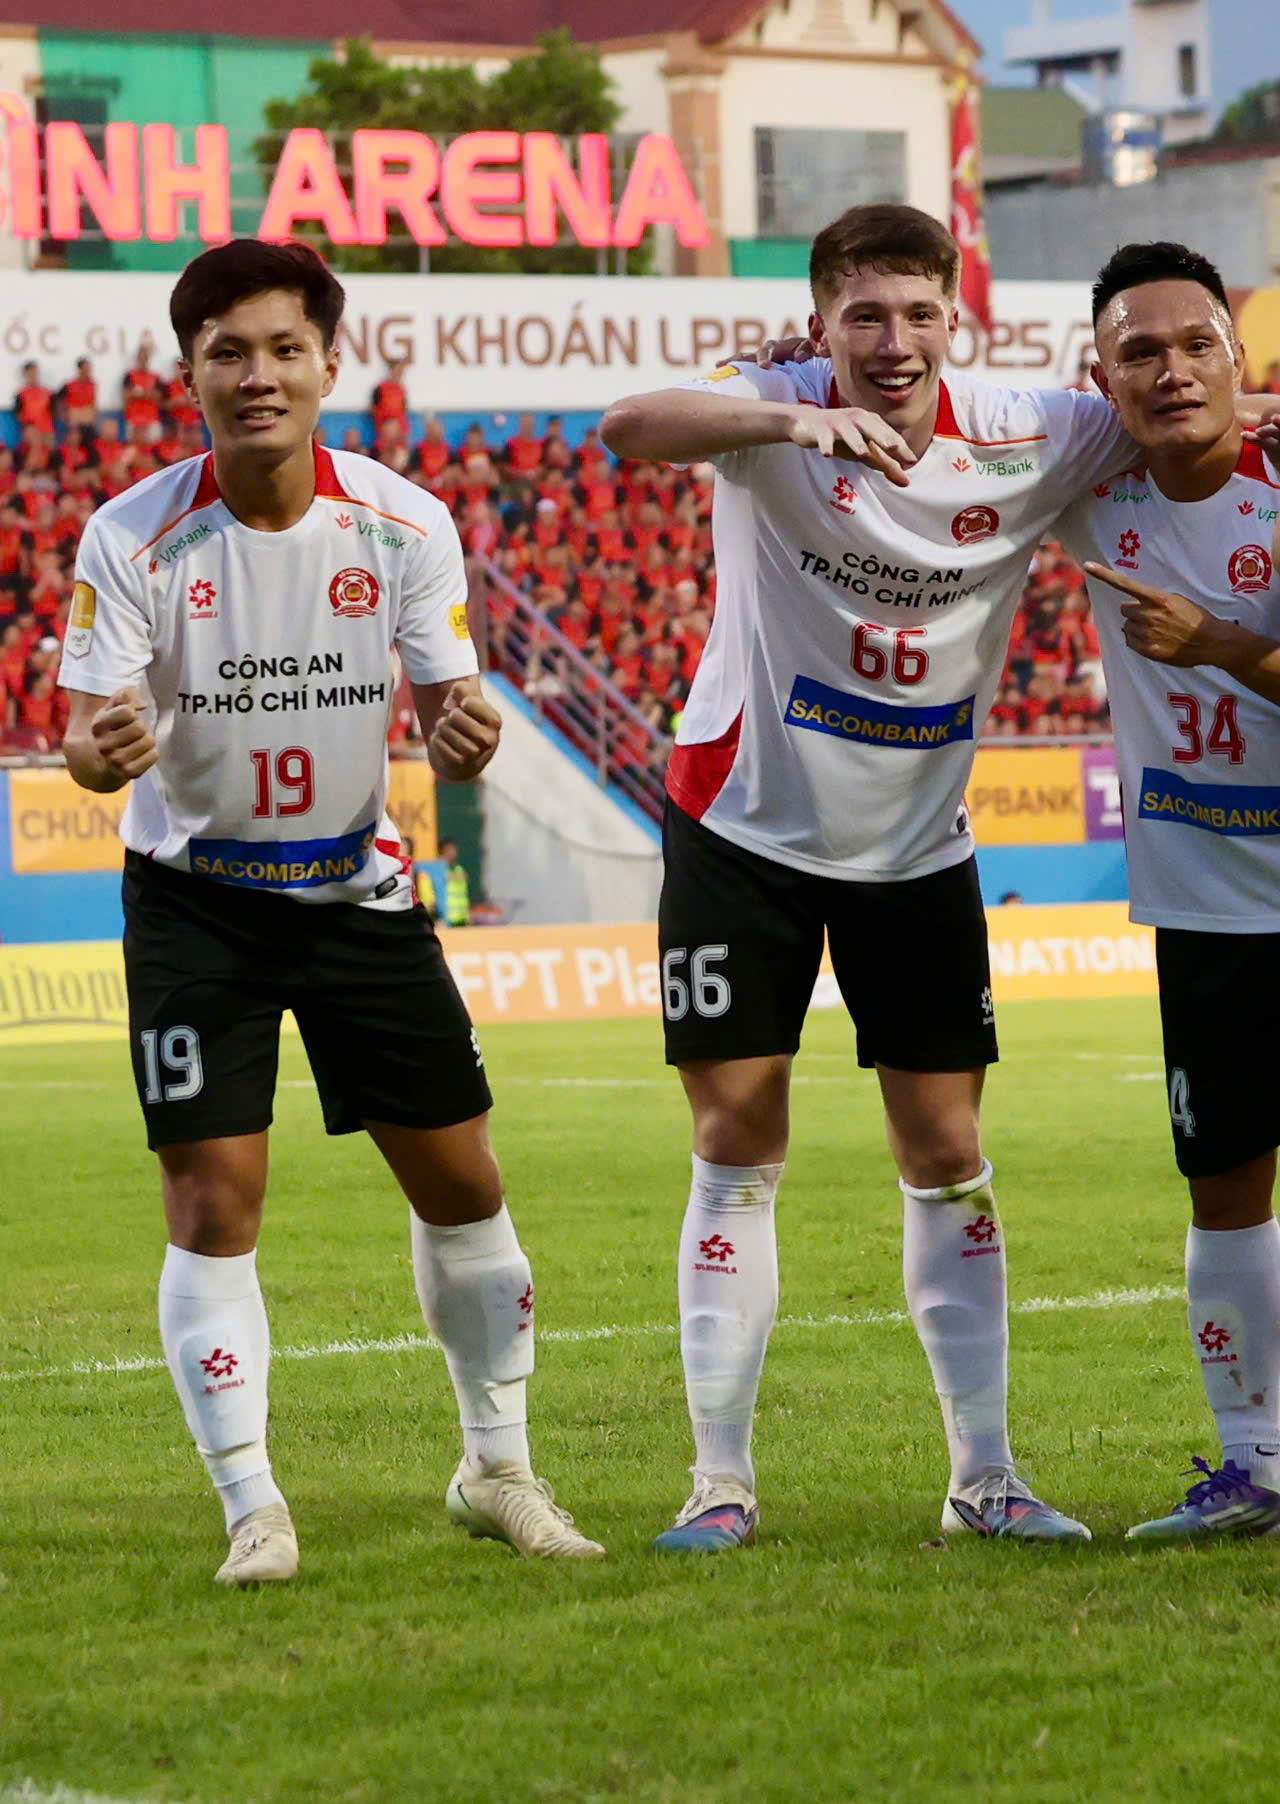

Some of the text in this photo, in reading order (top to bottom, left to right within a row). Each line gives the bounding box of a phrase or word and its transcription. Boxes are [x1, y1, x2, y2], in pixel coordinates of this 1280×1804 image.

[258, 127, 710, 248] ARENA
[435, 301, 637, 367] KHOÁN
[976, 458, 1034, 476] VPBank
[843, 553, 964, 584] CÔNG AN
[875, 588, 925, 608] CHÍ
[217, 652, 344, 681] CÔNG AN
[850, 620, 930, 686] 66
[178, 682, 386, 715] TP.HỒ CHÍ MINH
[788, 699, 951, 743] SACOMBANK
[1167, 692, 1247, 766] 34
[249, 745, 317, 820] 19
[1143, 791, 1280, 828] SACOMBANK
[193, 853, 358, 883] SACOMBANK
[448, 947, 563, 1012] FPT
[660, 944, 732, 1021] 66
[141, 1024, 203, 1104] 19
[1170, 1066, 1196, 1138] 4
